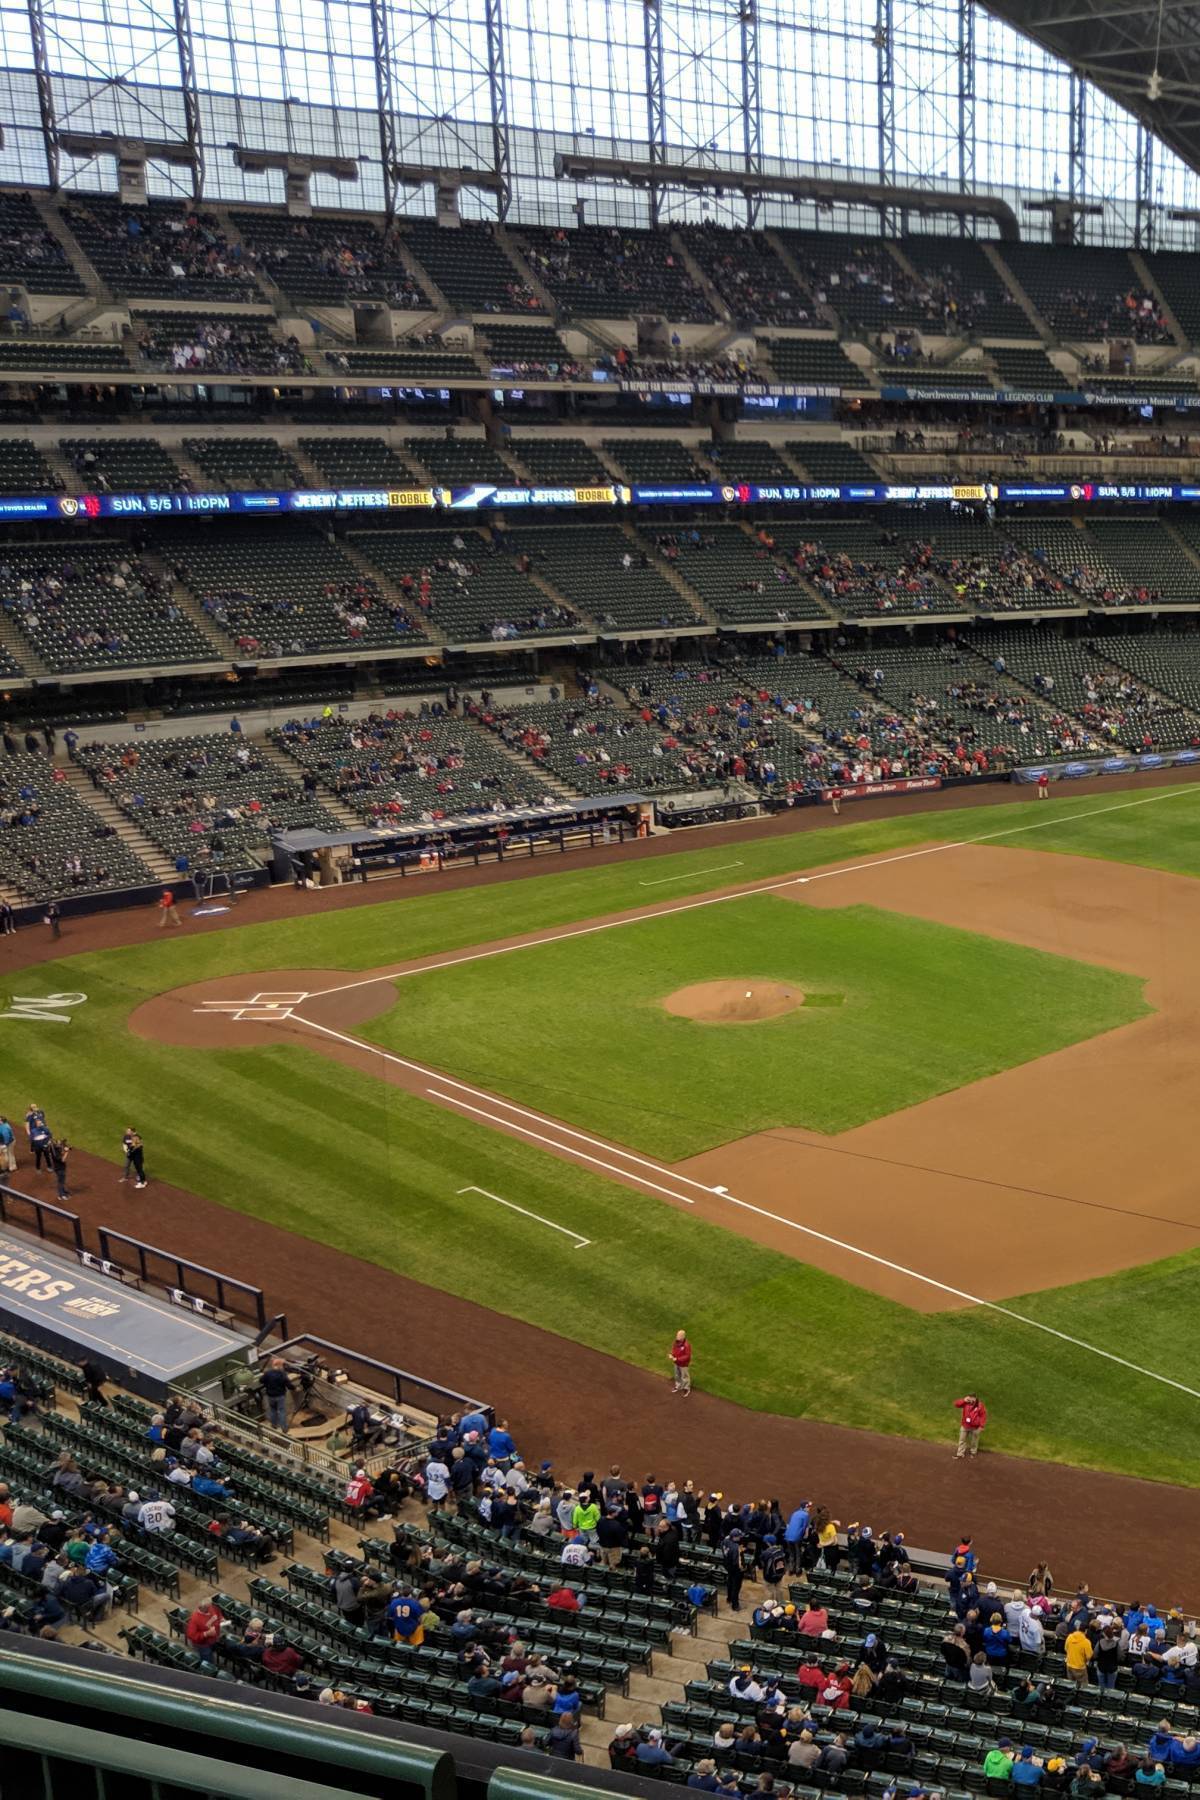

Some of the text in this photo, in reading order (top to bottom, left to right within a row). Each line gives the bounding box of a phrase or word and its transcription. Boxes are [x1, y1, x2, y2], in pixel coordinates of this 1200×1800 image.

[917, 389, 998, 401] Northwestern Mutual
[1004, 392, 1054, 402] LEGENDS CLUB
[1095, 395, 1177, 406] Northwestern Mutual
[493, 489, 610, 503] JEREMY JEFFRESS BOBBLE
[759, 488, 782, 500] SUN,
[784, 488, 800, 499] 5/5
[955, 486, 982, 498] BOBBLE
[113, 499, 146, 512] SUN,
[150, 499, 172, 511] 5/5
[189, 497, 230, 510] 1:10PM
[295, 494, 337, 507] JEREMY
[338, 493, 389, 507] JEFFRESS
[391, 493, 429, 505] BOBBLE
[0, 1254, 76, 1300] ERS
[147, 1512, 162, 1524] 20
[566, 1554, 579, 1565] 46
[396, 1604, 410, 1618] 19
[1130, 1639, 1144, 1651] 19
